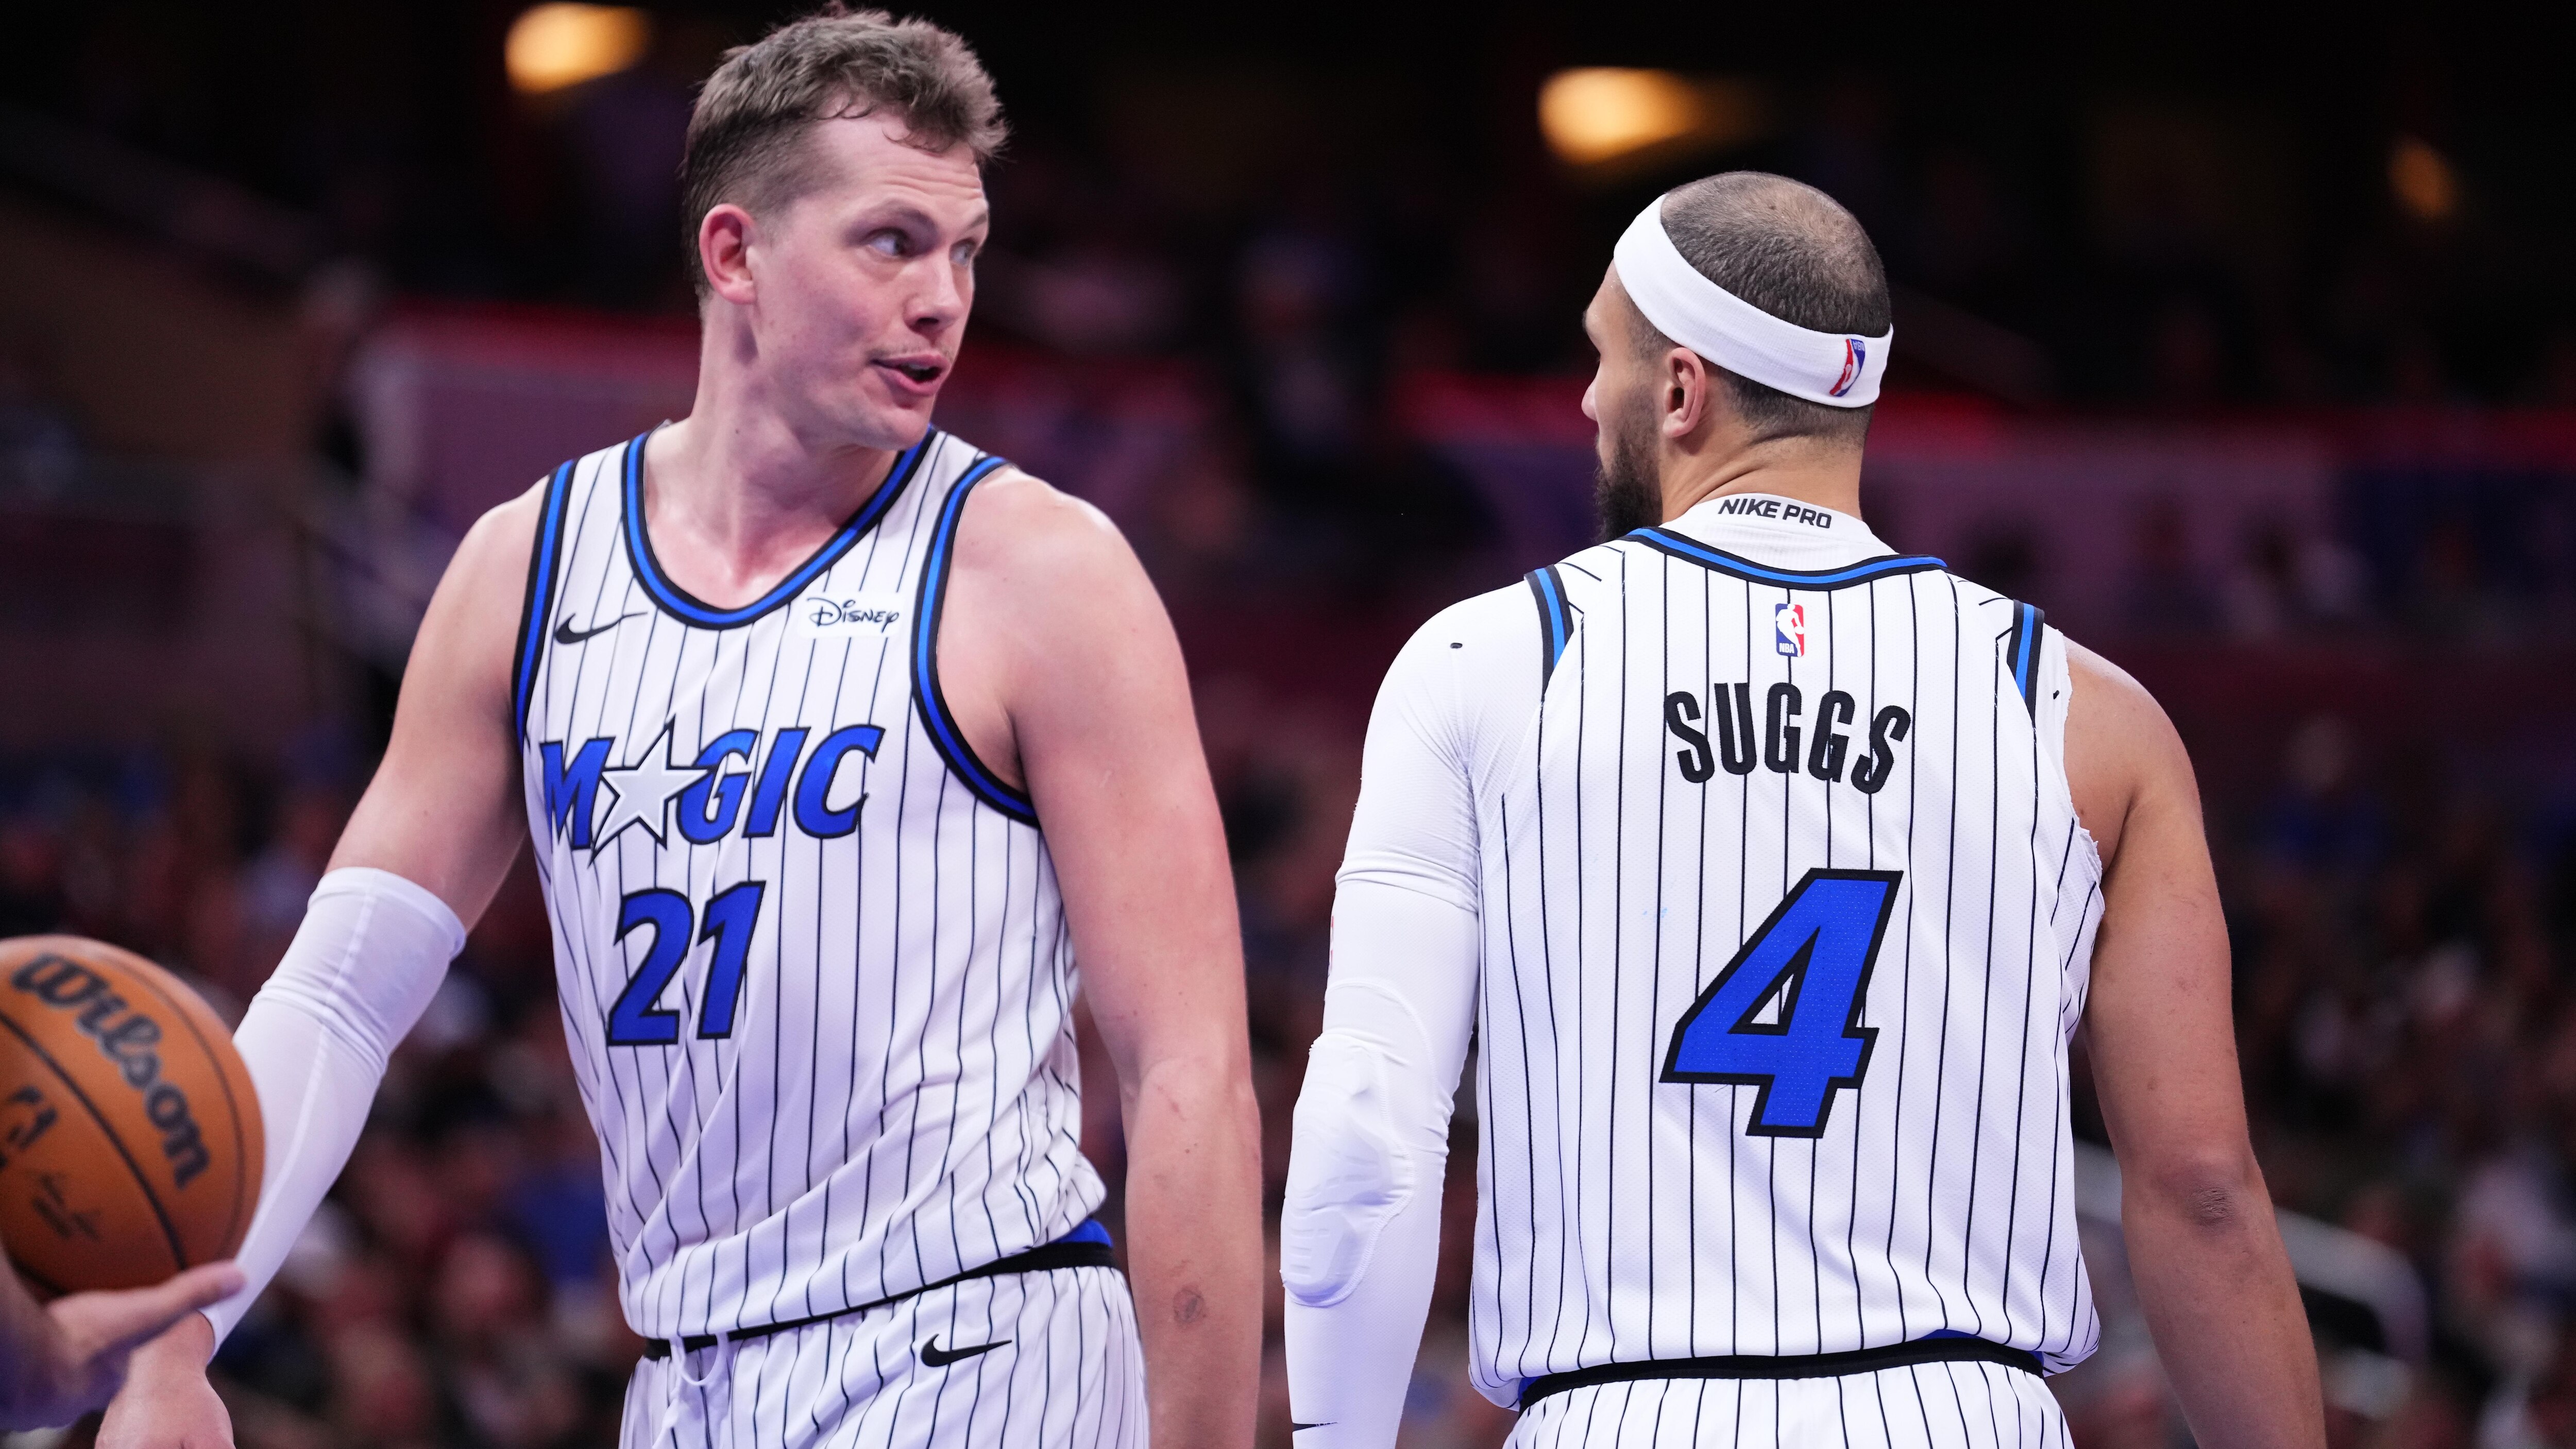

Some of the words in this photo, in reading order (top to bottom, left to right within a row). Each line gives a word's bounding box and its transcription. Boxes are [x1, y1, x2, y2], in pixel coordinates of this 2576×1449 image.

[1718, 498, 1781, 518] NIKE
[1782, 504, 1832, 529] PRO
[807, 597, 900, 634] Disney
[1779, 642, 1794, 654] NBA
[1664, 682, 1911, 794] SUGGS
[606, 880, 767, 1046] 21
[1658, 867, 1904, 1138] 4
[11, 953, 211, 1191] Wilson
